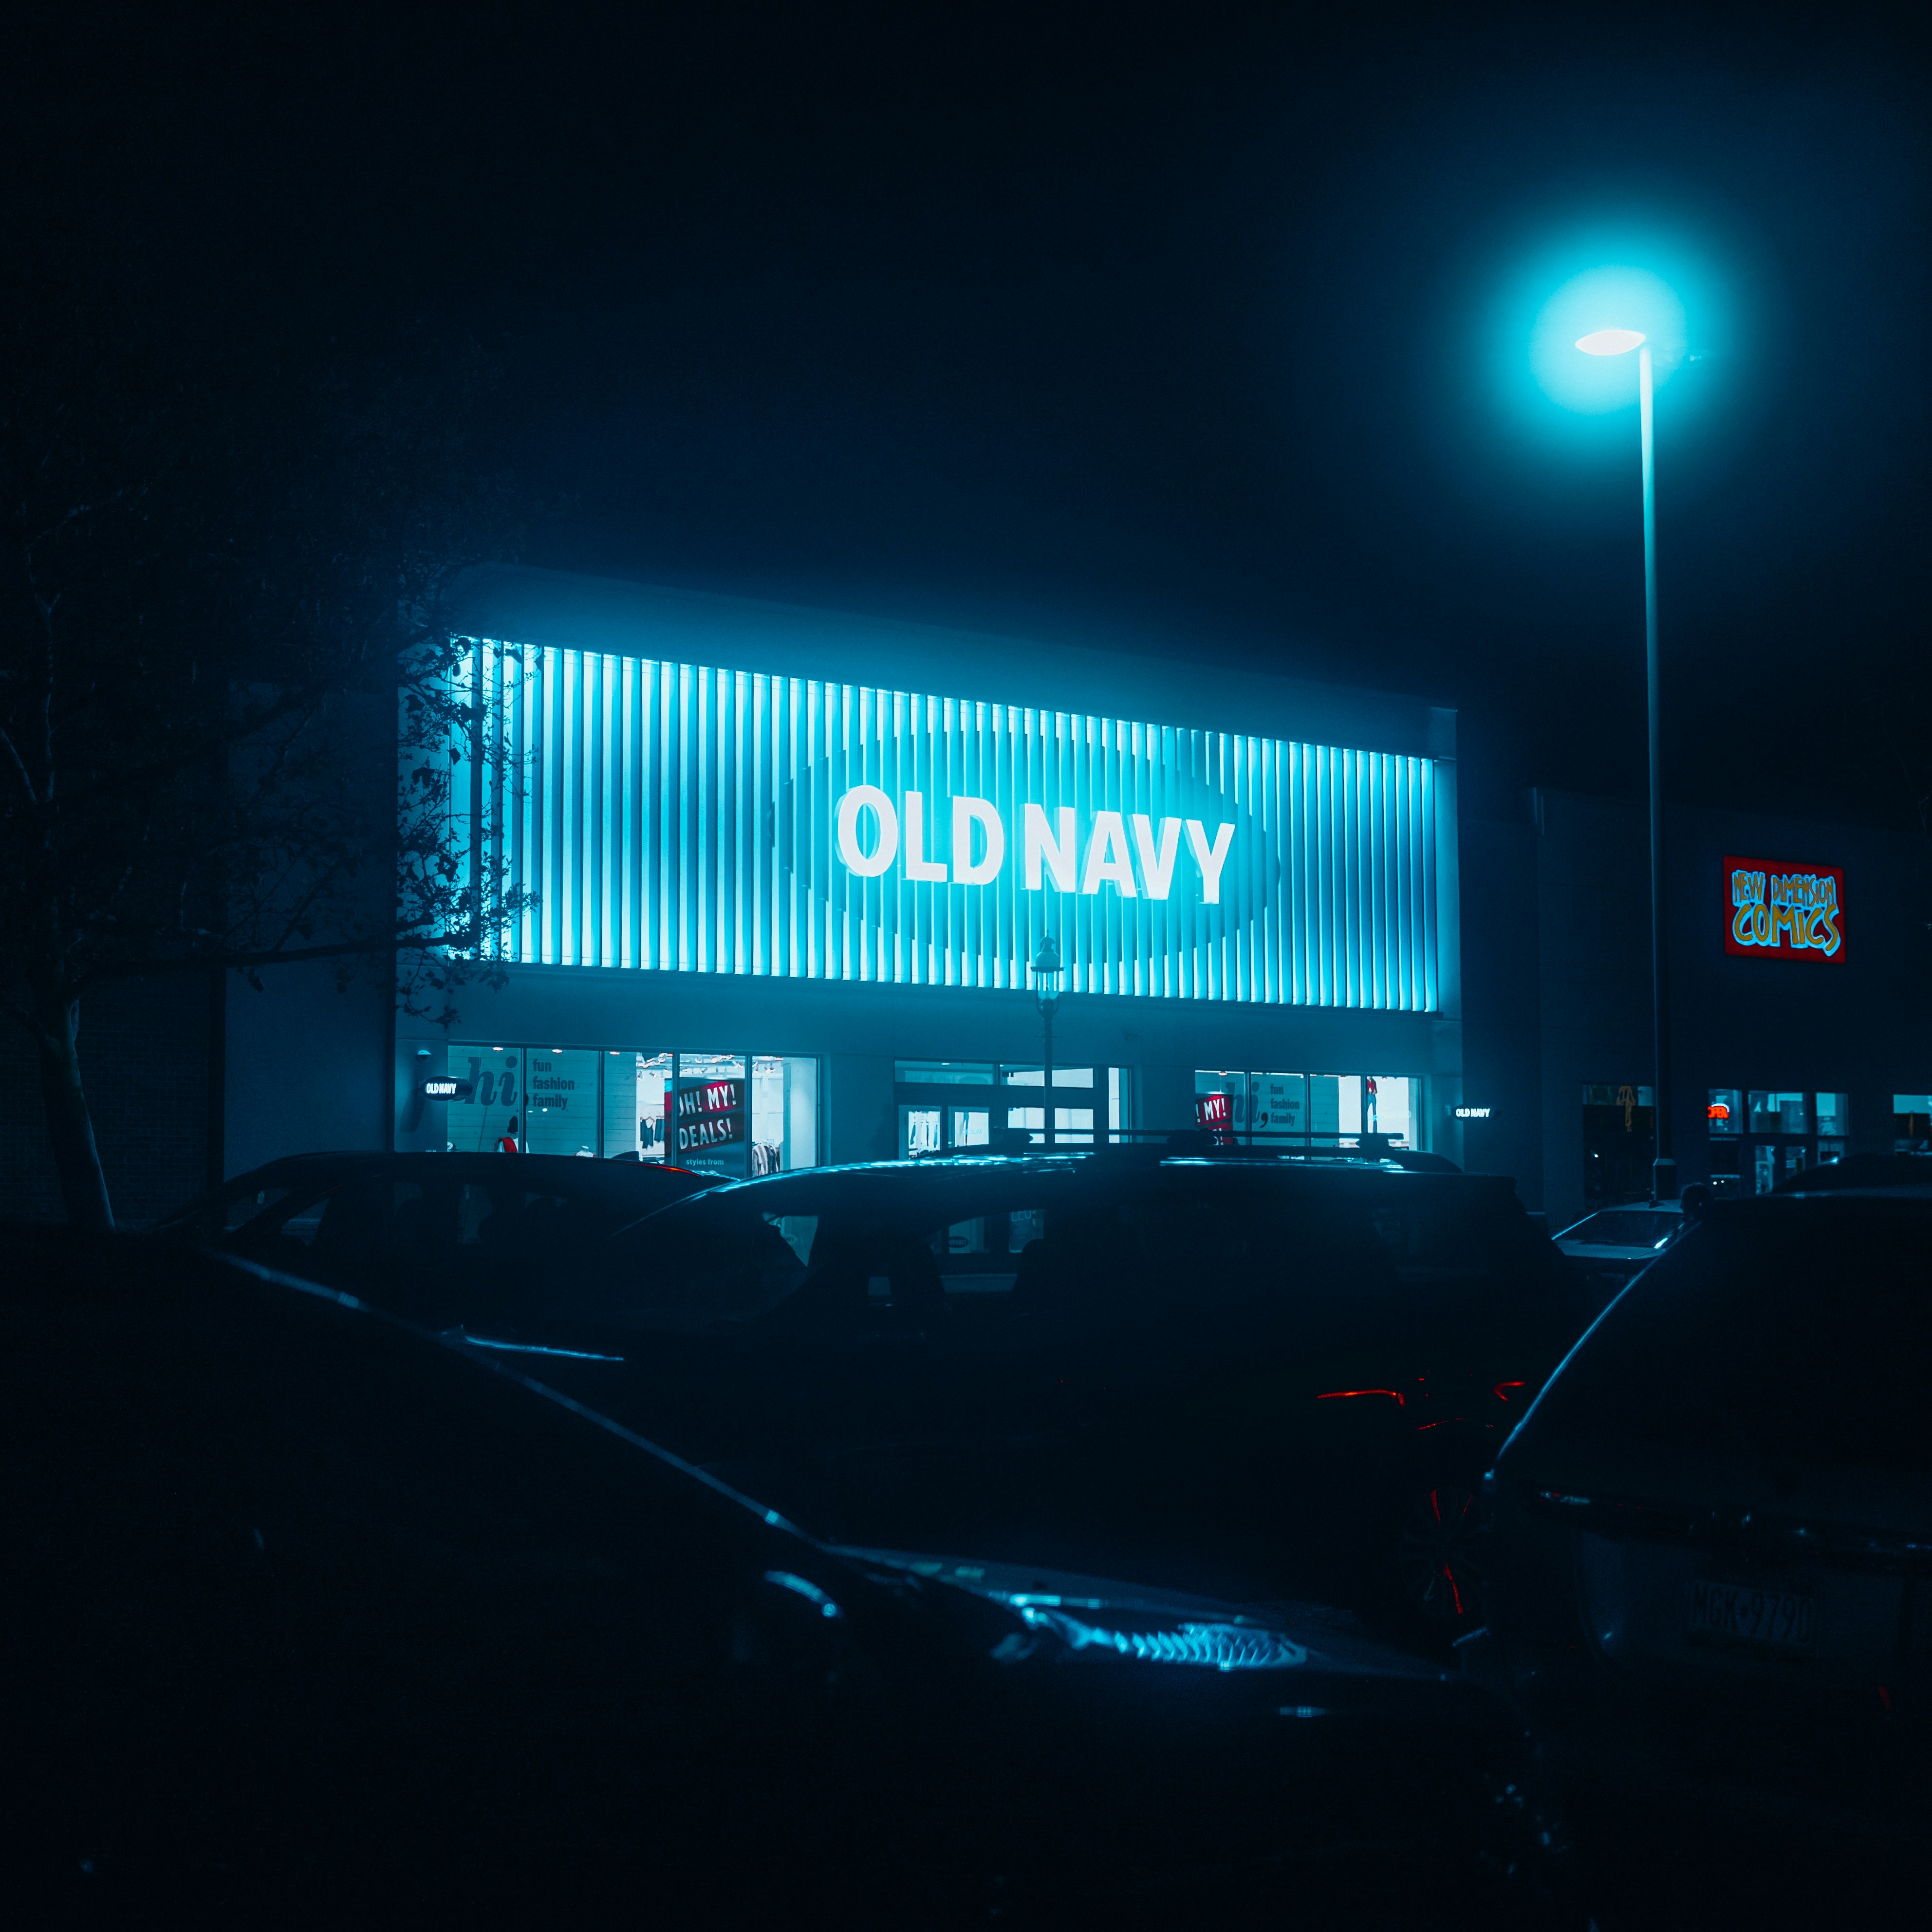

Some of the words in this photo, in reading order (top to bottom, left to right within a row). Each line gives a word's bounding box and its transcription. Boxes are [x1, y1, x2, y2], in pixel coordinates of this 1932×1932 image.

[835, 784, 1004, 885] OLD
[1020, 803, 1236, 905] NAVY
[1732, 870, 1765, 906] NEW
[1771, 874, 1836, 908] DIMENSION
[1732, 903, 1840, 956] COMICS
[533, 1059, 552, 1072] fun
[426, 1083, 439, 1094] OLD
[439, 1083, 457, 1094] NAVY
[533, 1077, 575, 1091] fashion
[1270, 1083, 1284, 1095] fun
[533, 1094, 568, 1111] family
[707, 1084, 736, 1110] MY!
[1270, 1098, 1300, 1110] fashion
[1204, 1098, 1226, 1121] MY!
[1455, 1108, 1470, 1117] OLD
[1470, 1108, 1491, 1117] NAVY
[1270, 1113, 1296, 1127] family
[679, 1118, 733, 1150] DEALS!
